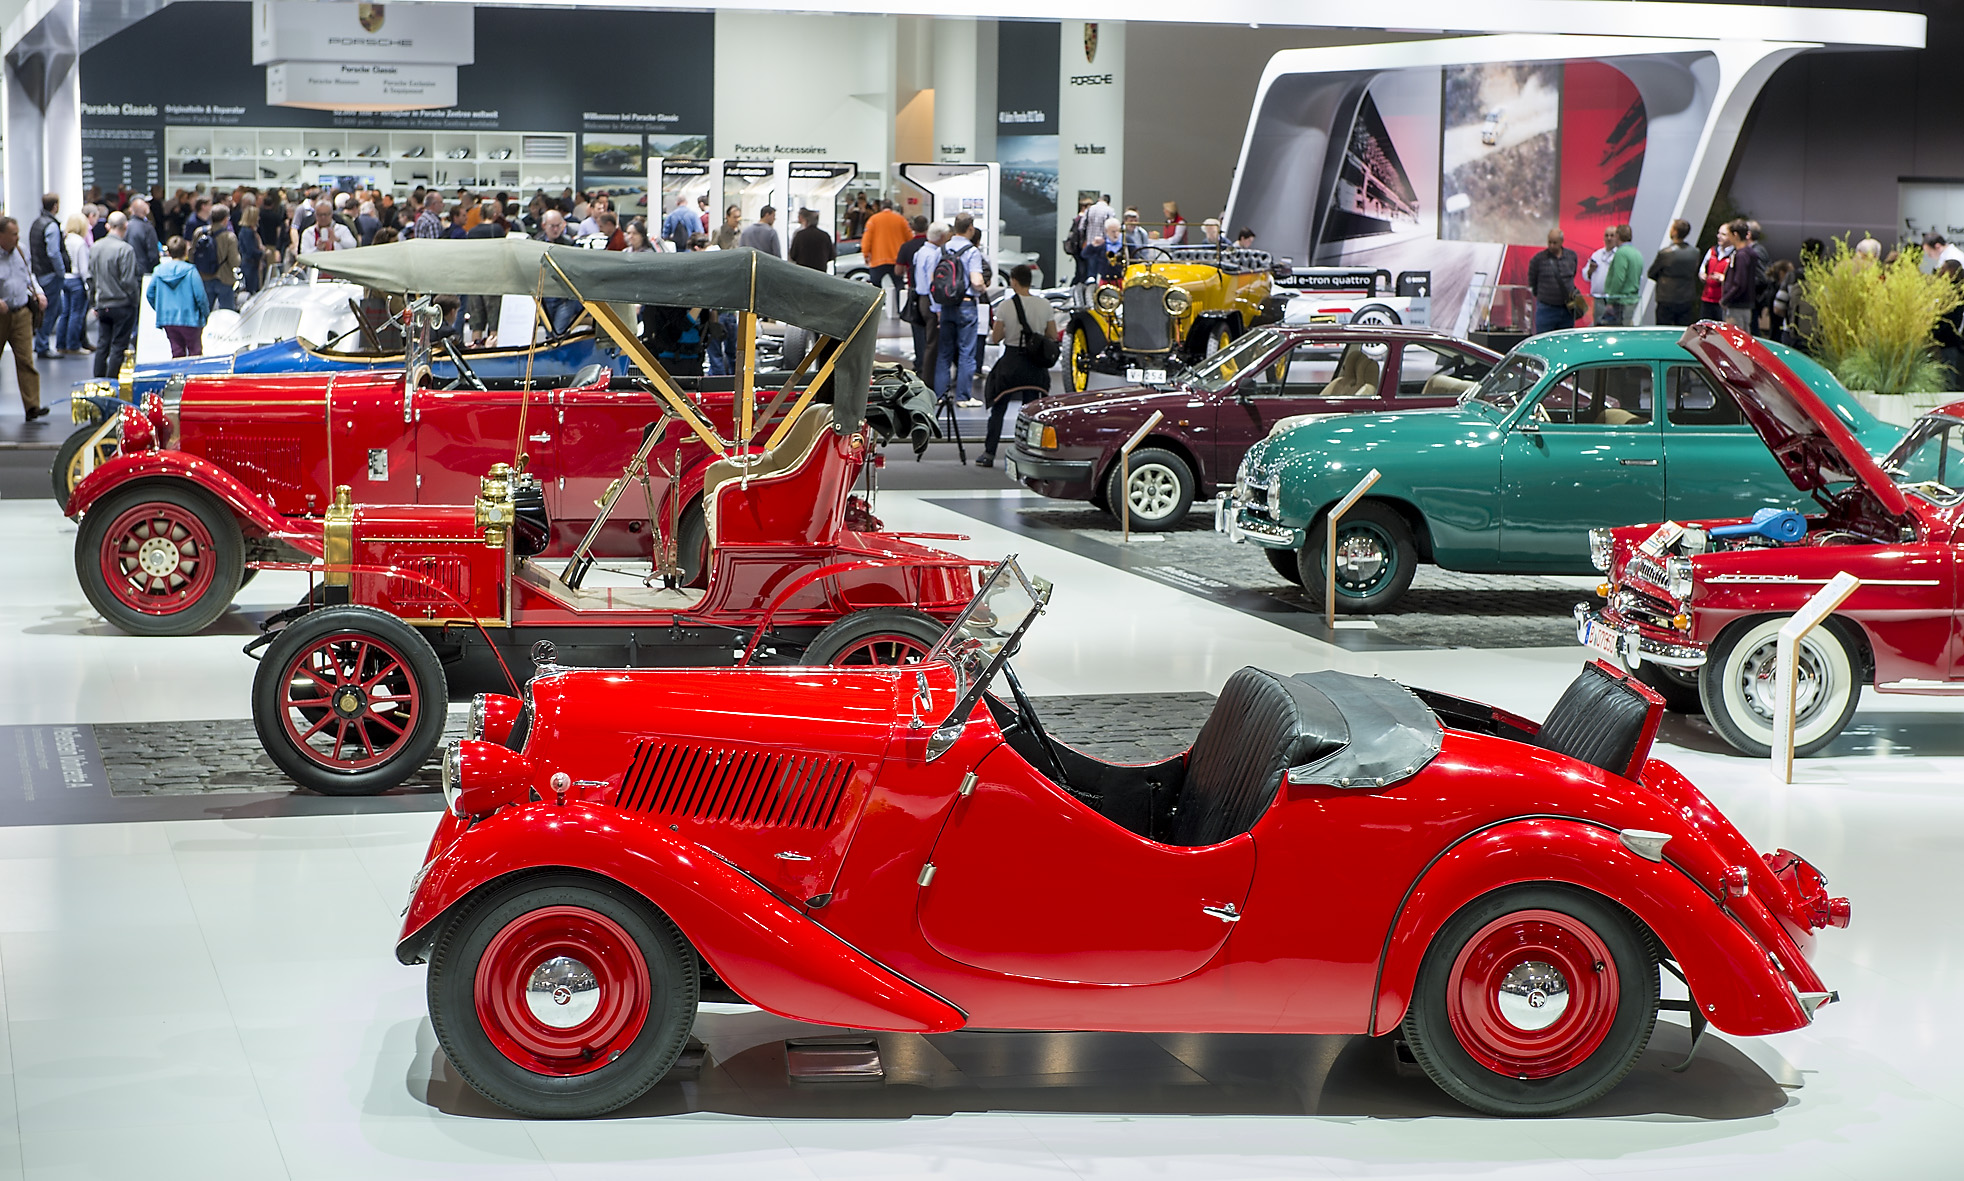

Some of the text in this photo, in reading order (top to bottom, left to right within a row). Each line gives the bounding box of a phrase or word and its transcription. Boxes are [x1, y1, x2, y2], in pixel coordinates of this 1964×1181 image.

[328, 37, 413, 47] PORSCHE
[341, 65, 397, 74] Porsche Classic
[1071, 74, 1113, 85] PORSCHE
[81, 103, 158, 116] Porsche Classic
[631, 113, 657, 122] Porsche
[657, 113, 680, 122] Classic
[735, 144, 827, 154] Porsche Accessoires
[790, 169, 805, 177] Audi
[1275, 276, 1371, 287] udi e-tron quattro
[1589, 625, 1596, 643] B
